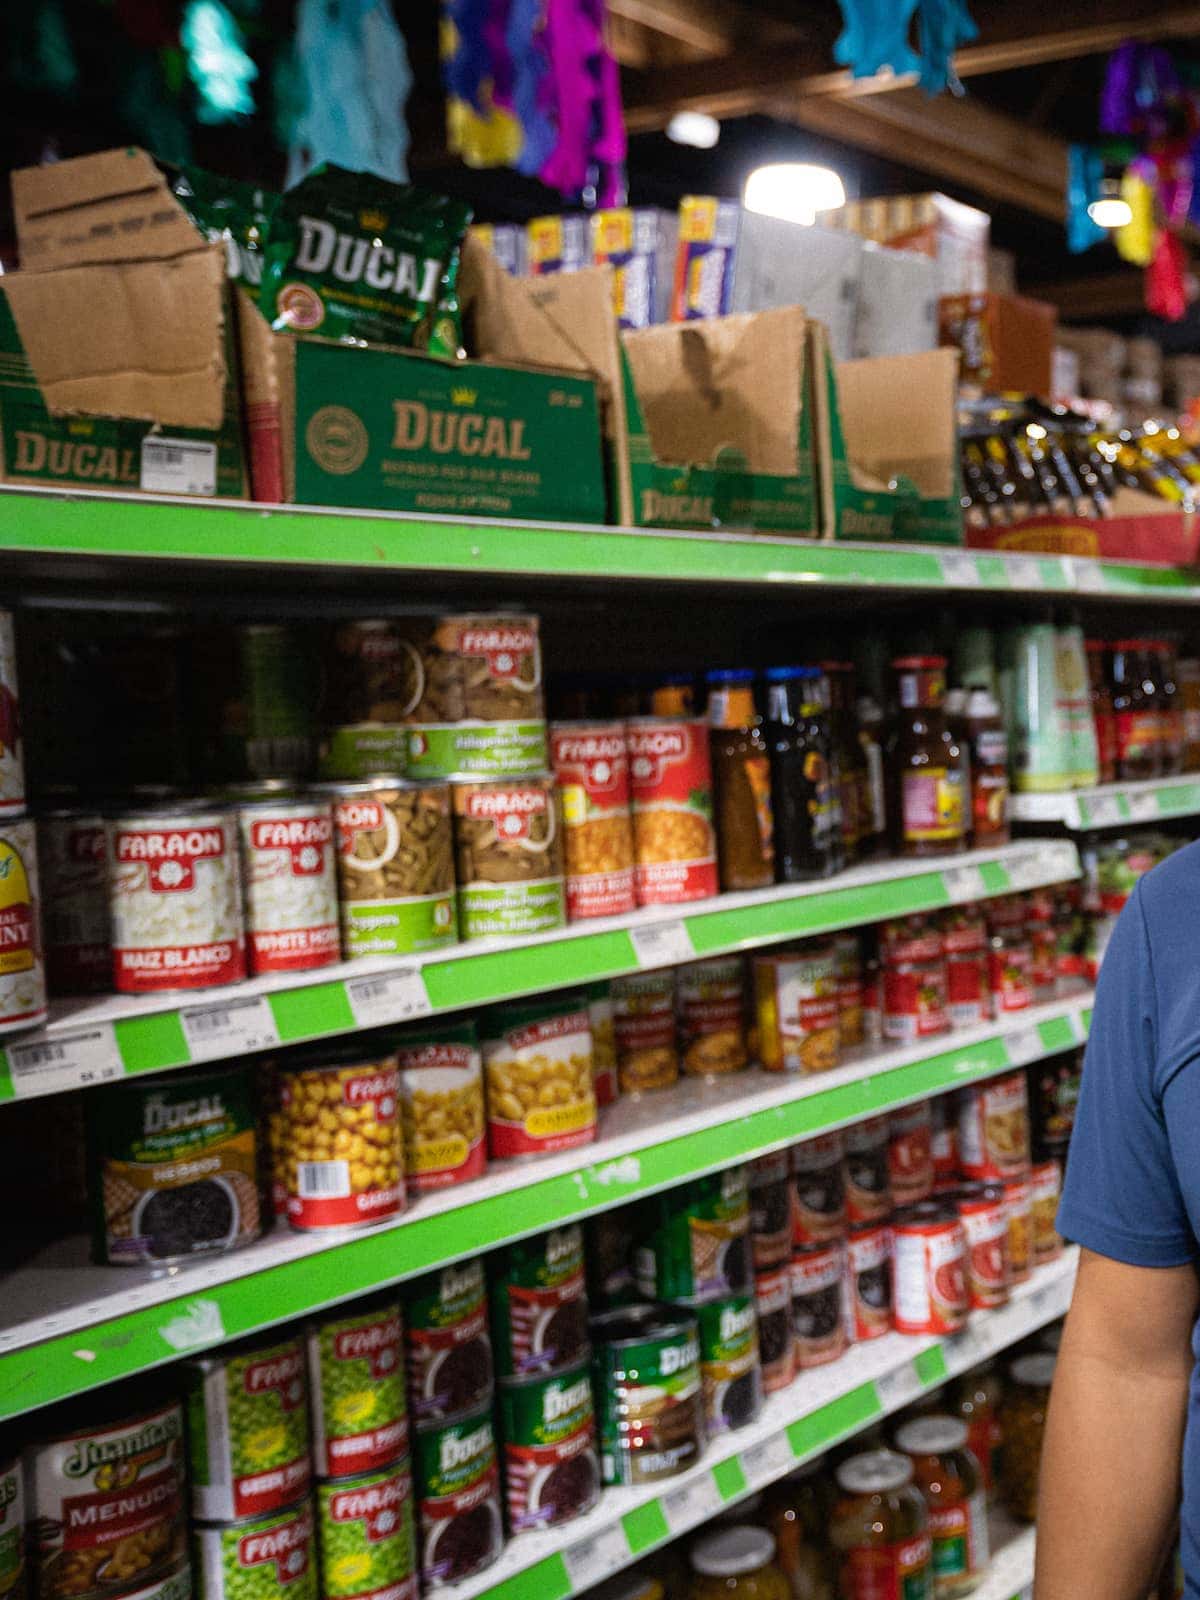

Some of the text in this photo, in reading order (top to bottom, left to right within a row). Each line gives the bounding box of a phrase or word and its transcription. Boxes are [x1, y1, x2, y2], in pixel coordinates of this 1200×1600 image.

[391, 399, 532, 461] DUCAL
[14, 431, 138, 482] DUCAL
[462, 629, 536, 651] FARAON
[470, 788, 547, 814] FARAON
[119, 831, 222, 858] FARAON
[258, 820, 331, 846] FARAO
[121, 945, 232, 970] MAIZ BLANCO
[143, 1092, 227, 1135] DUCAL
[69, 1480, 178, 1528] MENUDO
